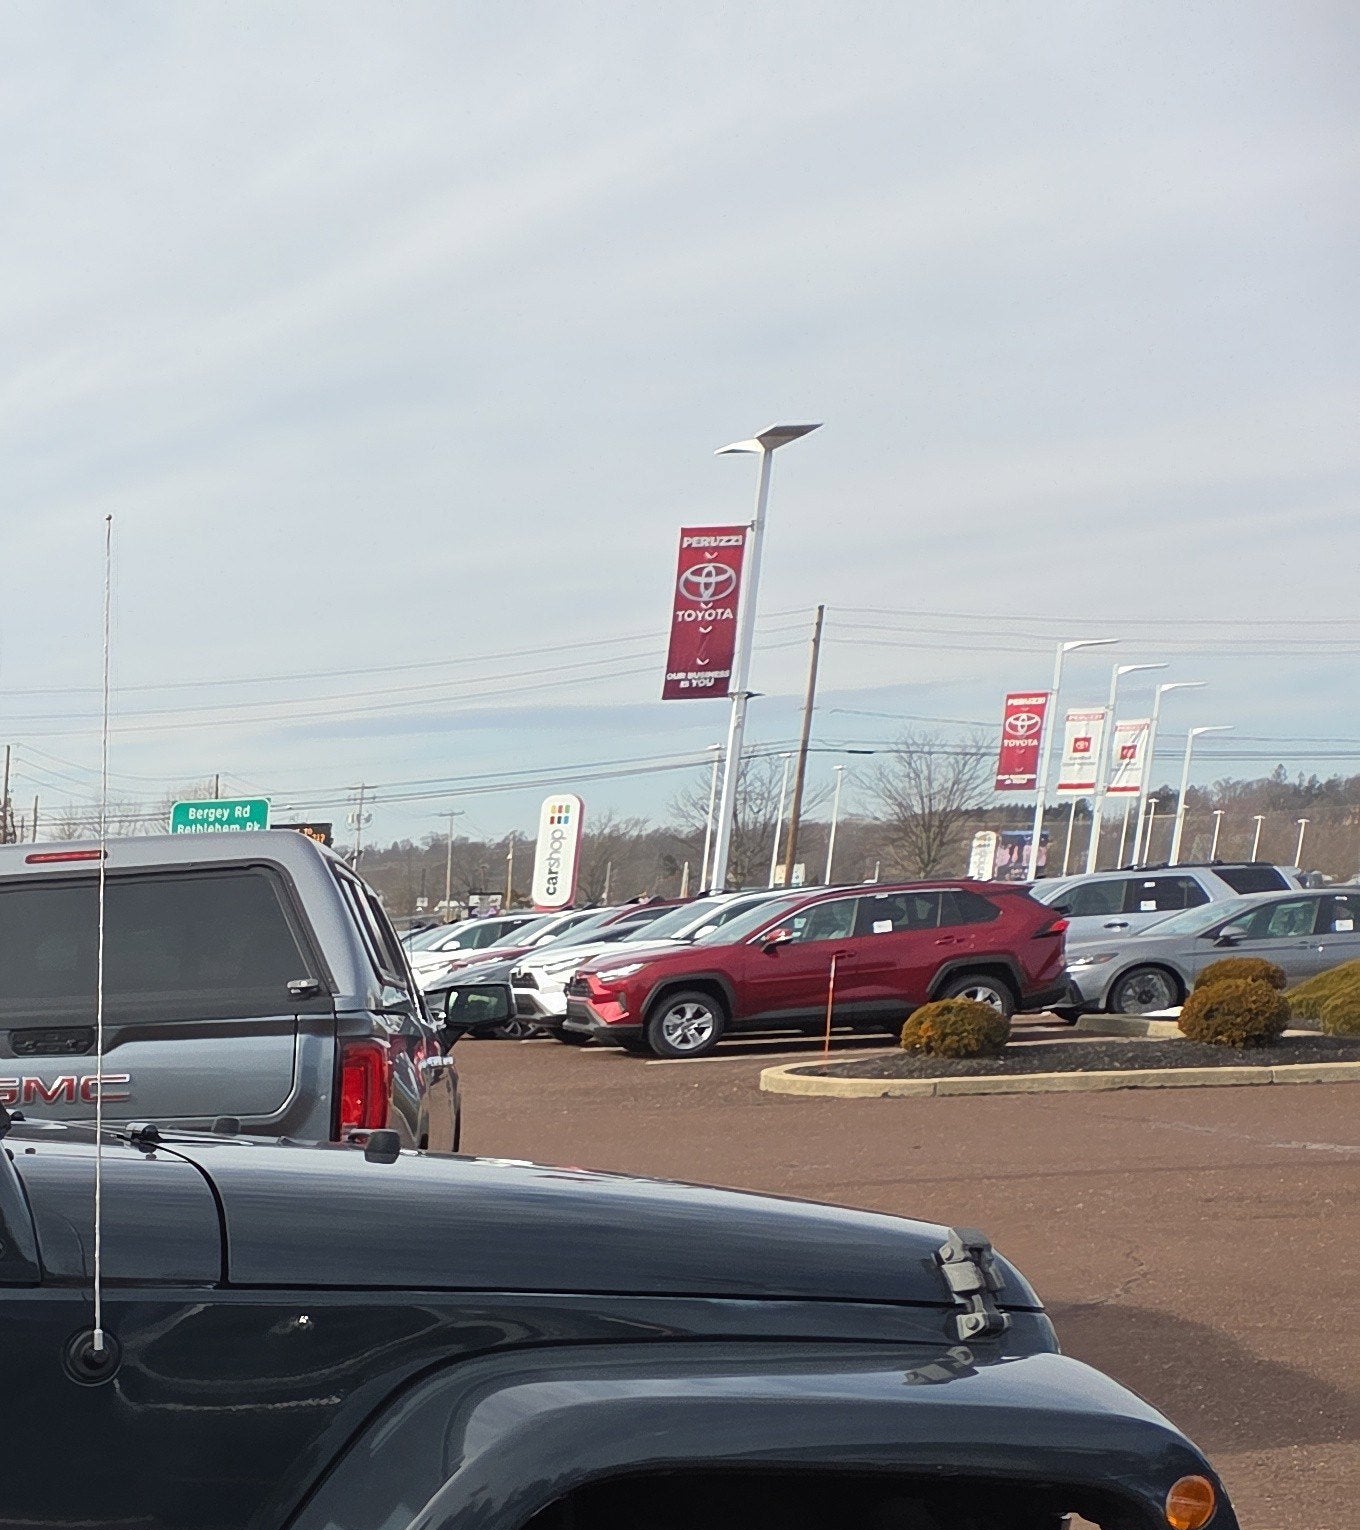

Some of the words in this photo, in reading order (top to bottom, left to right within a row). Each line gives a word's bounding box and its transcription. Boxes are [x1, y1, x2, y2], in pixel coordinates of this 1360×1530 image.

[682, 535, 743, 548] PERUZZI
[676, 608, 733, 622] TOYOTA
[1003, 739, 1039, 747] TOYOTA
[188, 807, 230, 821] Bergey
[234, 804, 251, 818] Rd
[545, 828, 567, 896] carshop
